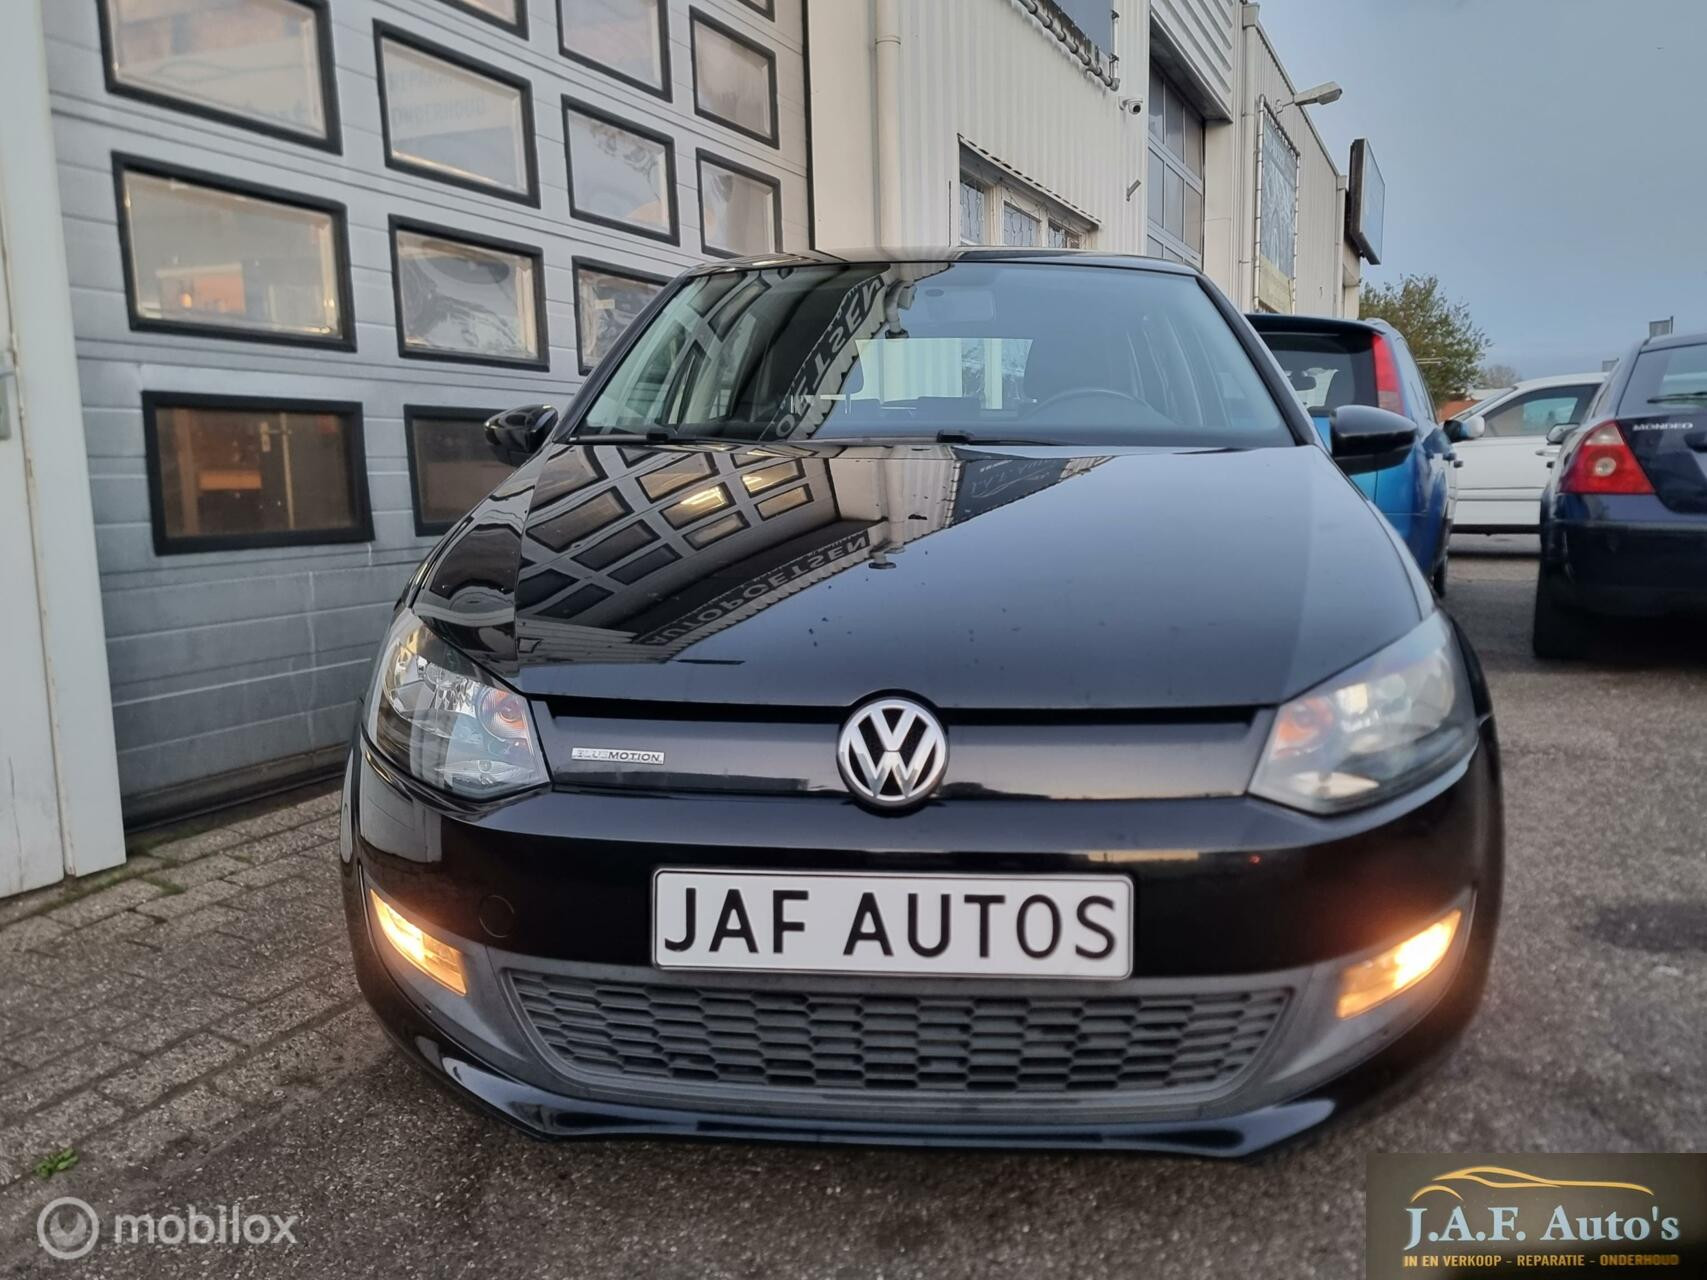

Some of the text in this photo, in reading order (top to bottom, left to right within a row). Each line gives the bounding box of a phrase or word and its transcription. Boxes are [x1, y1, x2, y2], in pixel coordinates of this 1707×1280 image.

[1633, 422, 1693, 431] MONDEO
[664, 886, 1116, 959] JAF AUTOS
